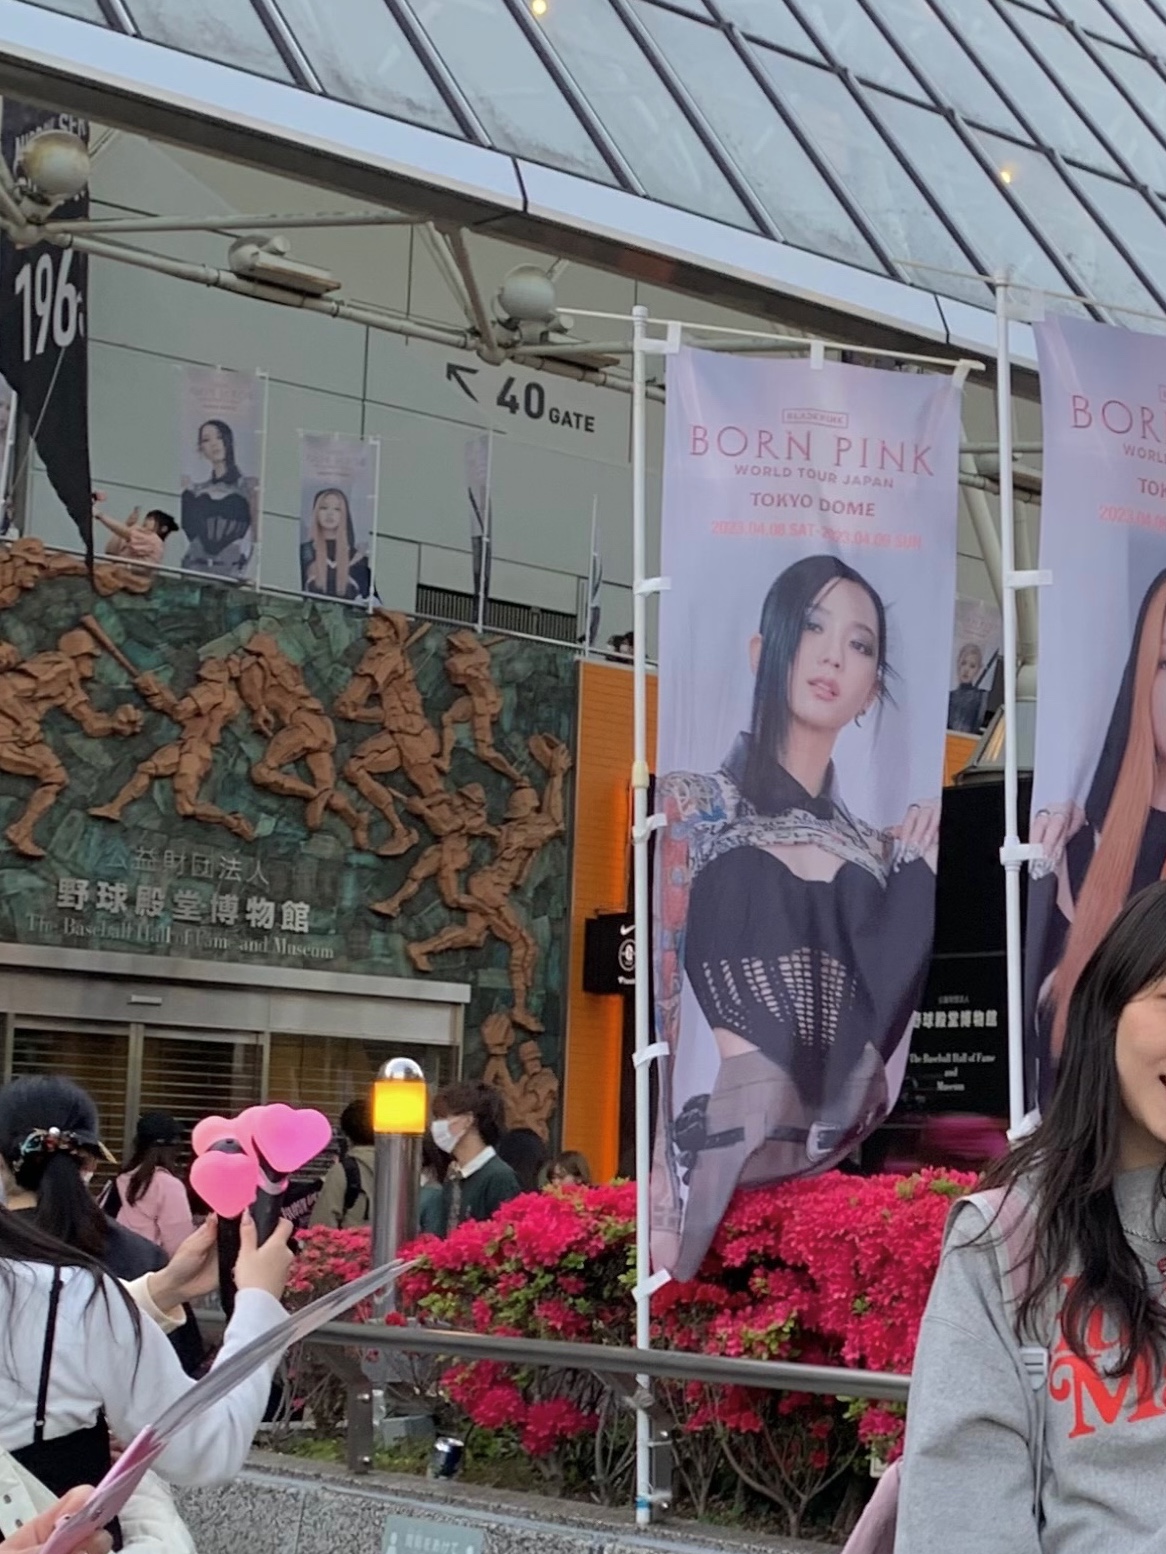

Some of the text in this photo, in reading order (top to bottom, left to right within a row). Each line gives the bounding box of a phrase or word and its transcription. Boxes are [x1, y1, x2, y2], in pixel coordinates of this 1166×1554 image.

[15, 248, 84, 362] 196
[496, 376, 595, 432] 40 GATE
[689, 425, 934, 476] BORN PINK
[734, 464, 894, 488] WORLD TOUR JAPAN
[751, 492, 875, 517] TOKYO DOME
[57, 878, 311, 933] 野球殿堂博物館
